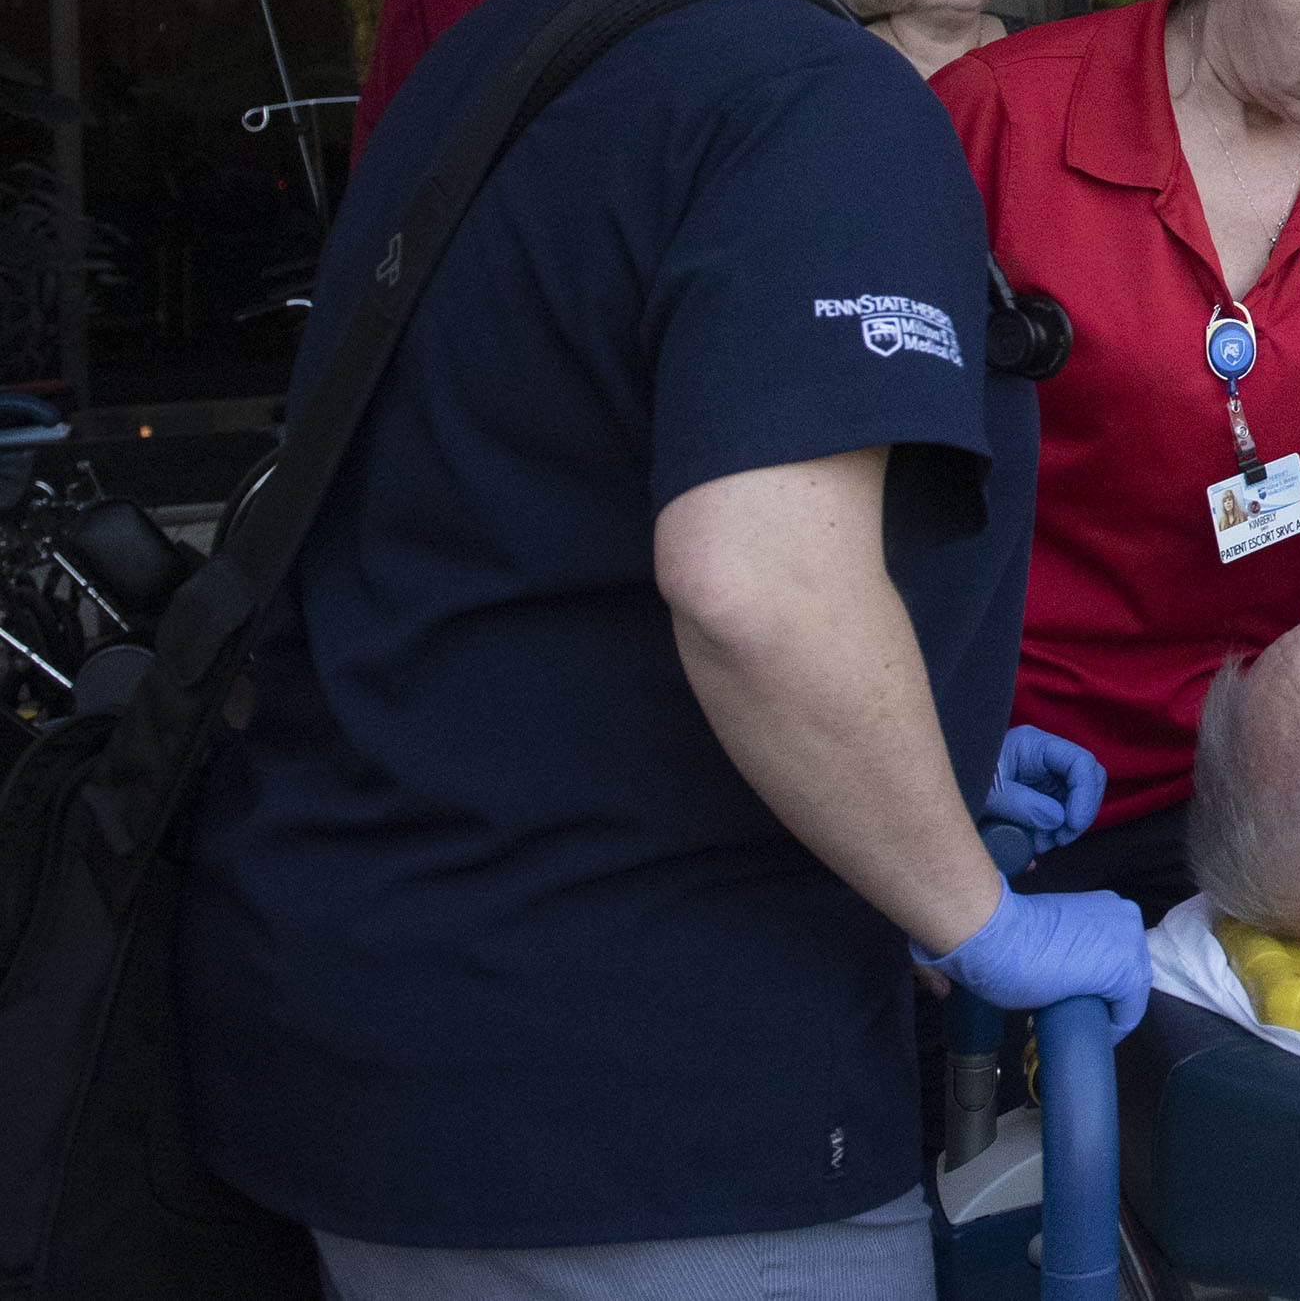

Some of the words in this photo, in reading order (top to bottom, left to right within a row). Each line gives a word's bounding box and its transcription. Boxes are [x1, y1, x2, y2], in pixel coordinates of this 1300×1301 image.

[1248, 511, 1277, 530] KIMBERLY
[1221, 541, 1247, 561] PATIENT
[1248, 530, 1276, 549] ESCORT
[1275, 521, 1295, 538] SRVC
